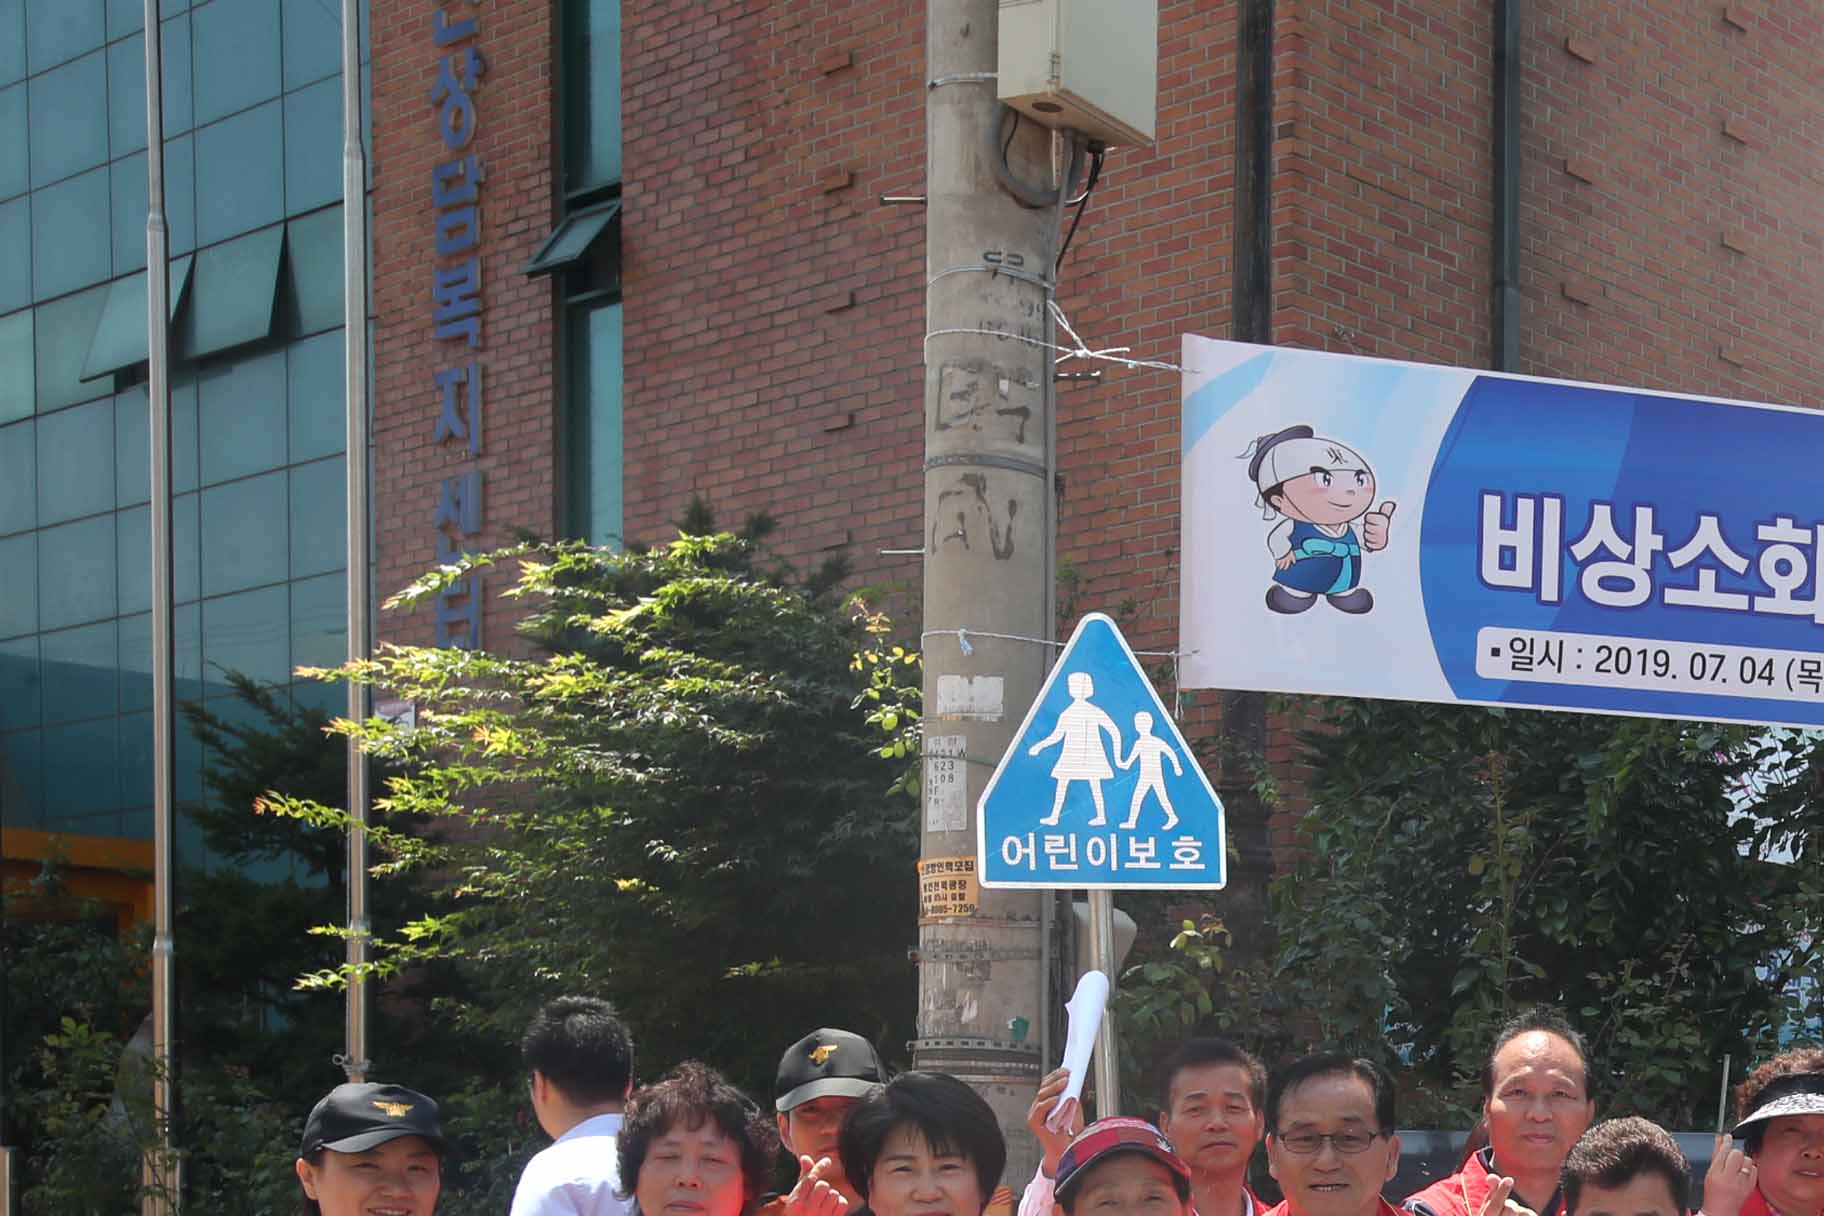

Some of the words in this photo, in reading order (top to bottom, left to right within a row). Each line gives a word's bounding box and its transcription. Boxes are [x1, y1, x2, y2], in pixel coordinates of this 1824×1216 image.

[1508, 636, 1564, 675] 일시
[1594, 644, 1678, 681] 2019.
[1689, 651, 1728, 684] 07.
[1739, 656, 1776, 687] 04
[1001, 832, 1206, 871] 어린이보호
